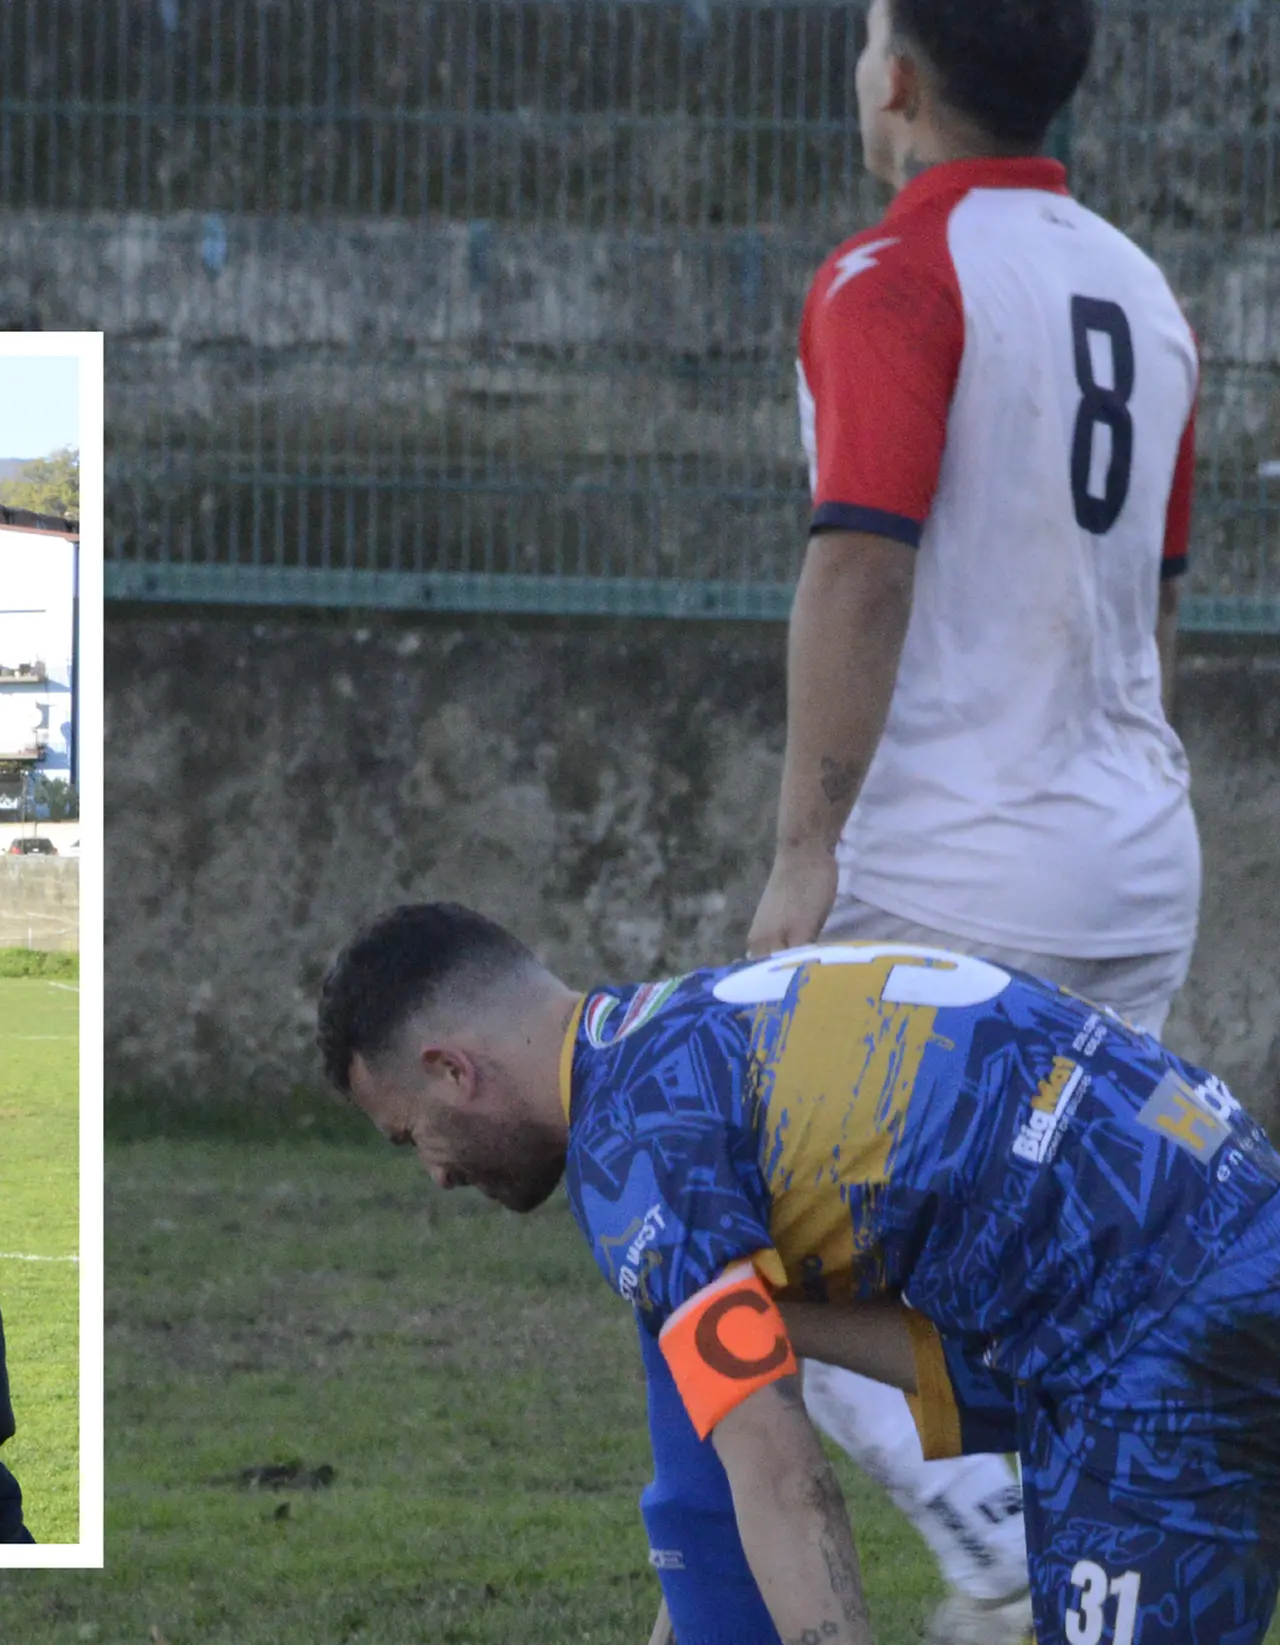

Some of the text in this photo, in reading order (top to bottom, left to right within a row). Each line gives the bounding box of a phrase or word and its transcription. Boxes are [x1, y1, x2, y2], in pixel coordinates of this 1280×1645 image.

[1070, 295, 1135, 535] 8
[695, 1289, 788, 1379] C
[1066, 1559, 1141, 1645] 31
